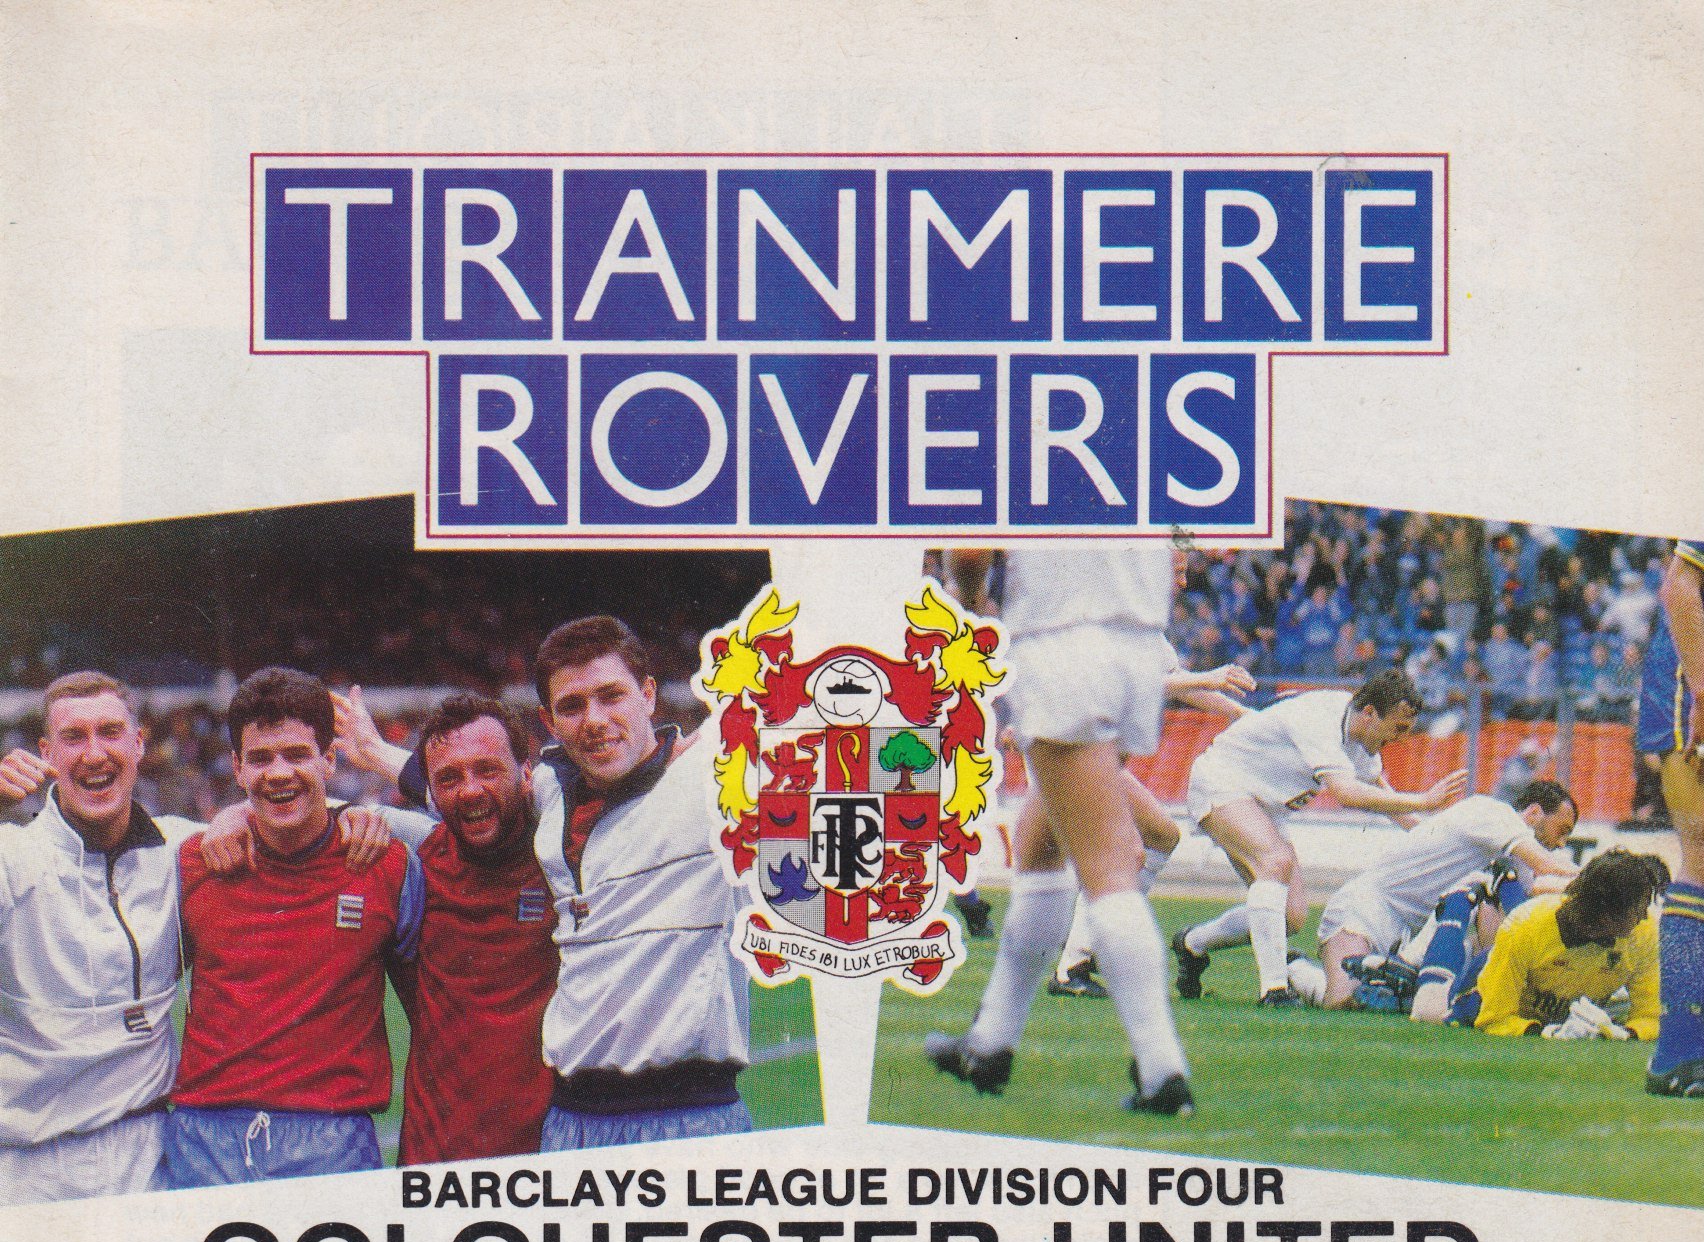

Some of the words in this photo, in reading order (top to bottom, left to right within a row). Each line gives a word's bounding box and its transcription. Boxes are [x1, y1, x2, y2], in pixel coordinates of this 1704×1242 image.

[284, 188, 1418, 322] TRANMERE
[460, 371, 1240, 507] ROVERS
[750, 933, 771, 952] UBI
[779, 942, 816, 961] FIDES
[819, 953, 838, 969] IBI
[843, 956, 871, 971] LUX
[893, 943, 945, 963] ROBUR
[403, 1167, 665, 1208] BARCLAYS
[688, 1169, 887, 1206] LEAGUE
[909, 1168, 1126, 1206] DIVISION
[1149, 1168, 1283, 1206] FOUR
